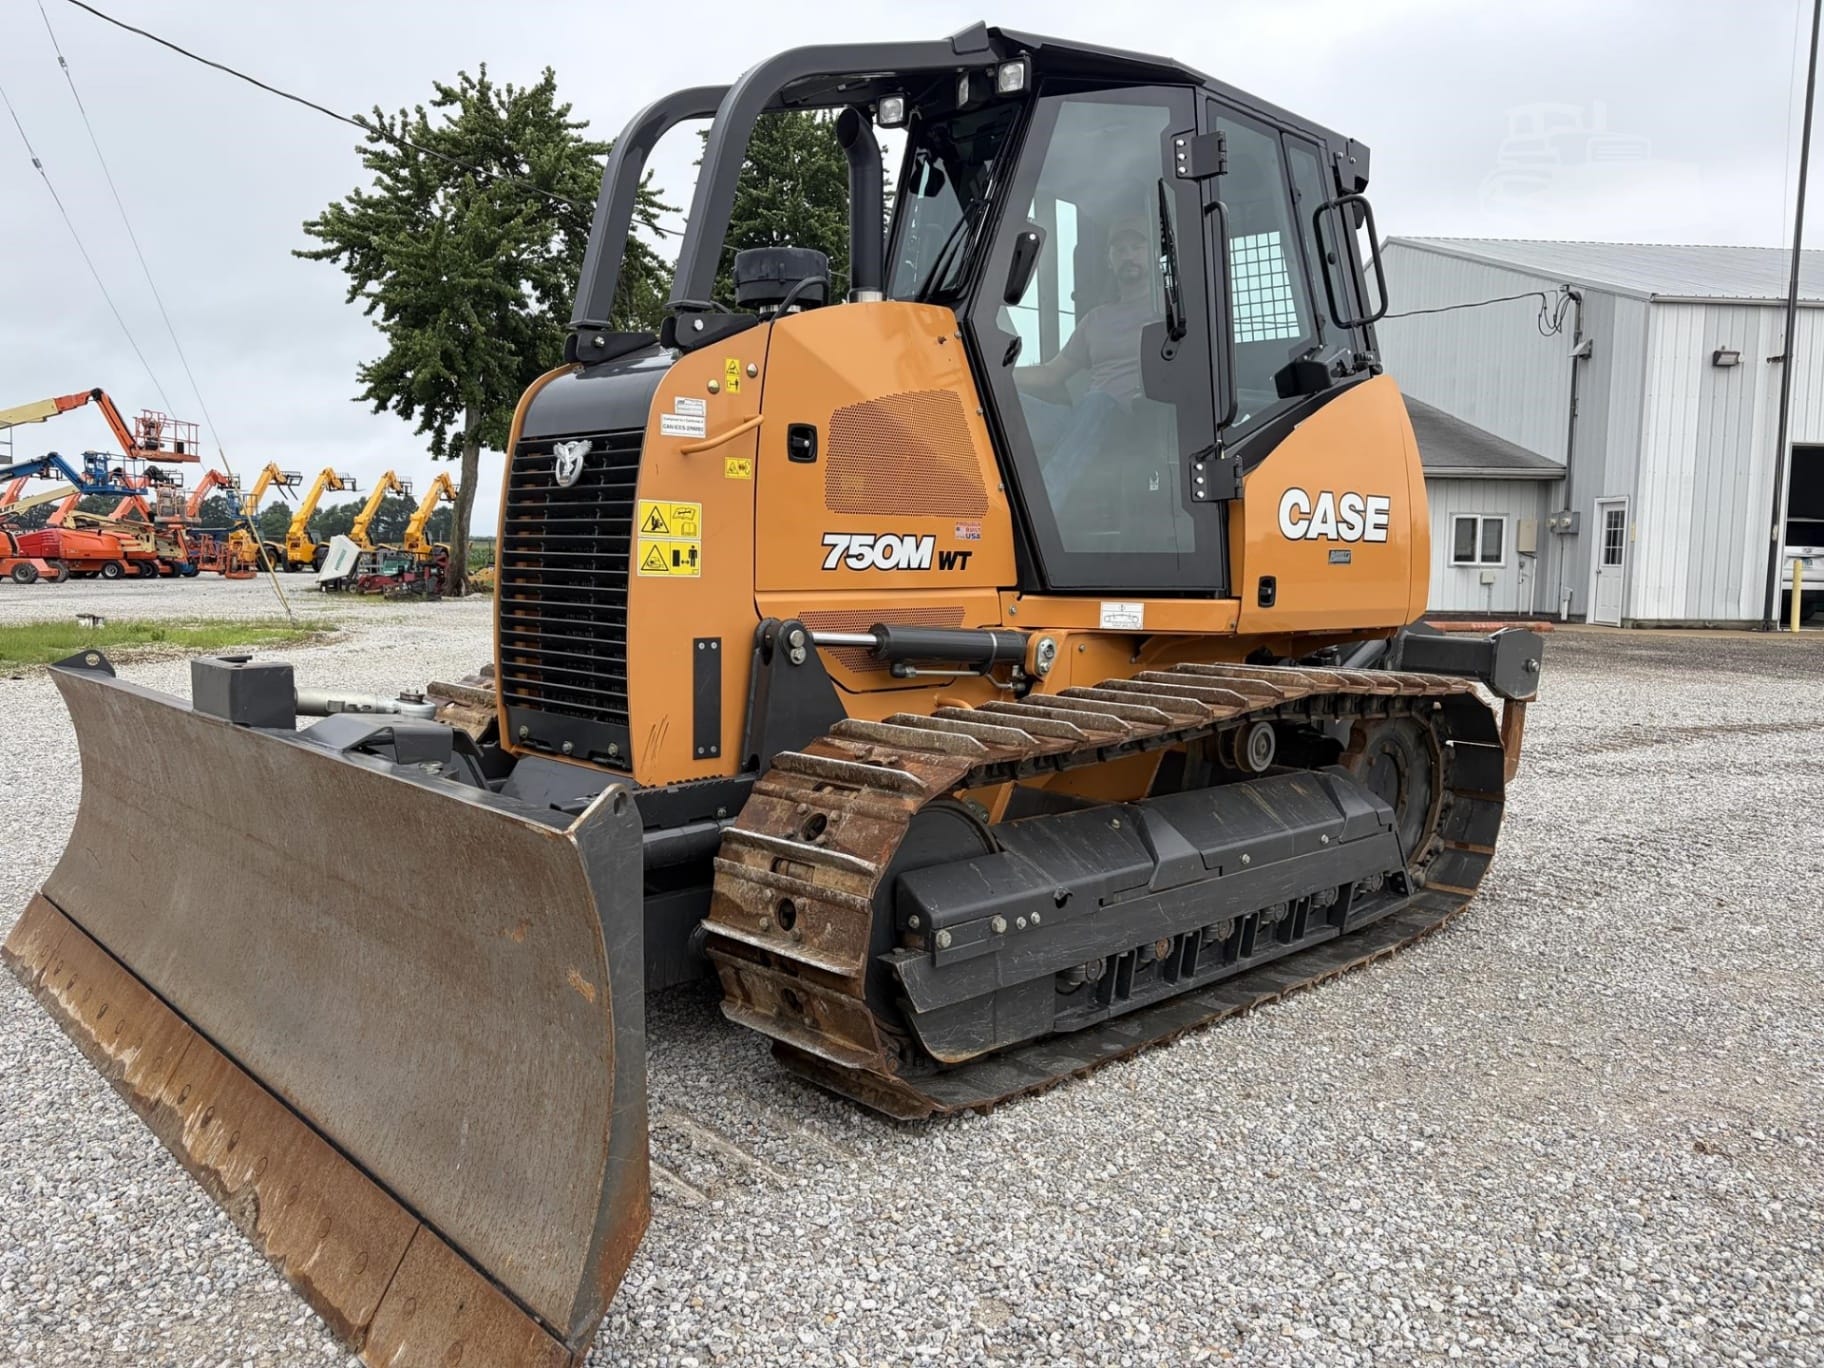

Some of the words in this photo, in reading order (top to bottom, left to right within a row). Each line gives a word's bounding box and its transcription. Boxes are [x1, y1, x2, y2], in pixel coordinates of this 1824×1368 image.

[1278, 487, 1391, 543] CASE
[821, 533, 936, 571] 750M
[938, 550, 972, 570] WT
